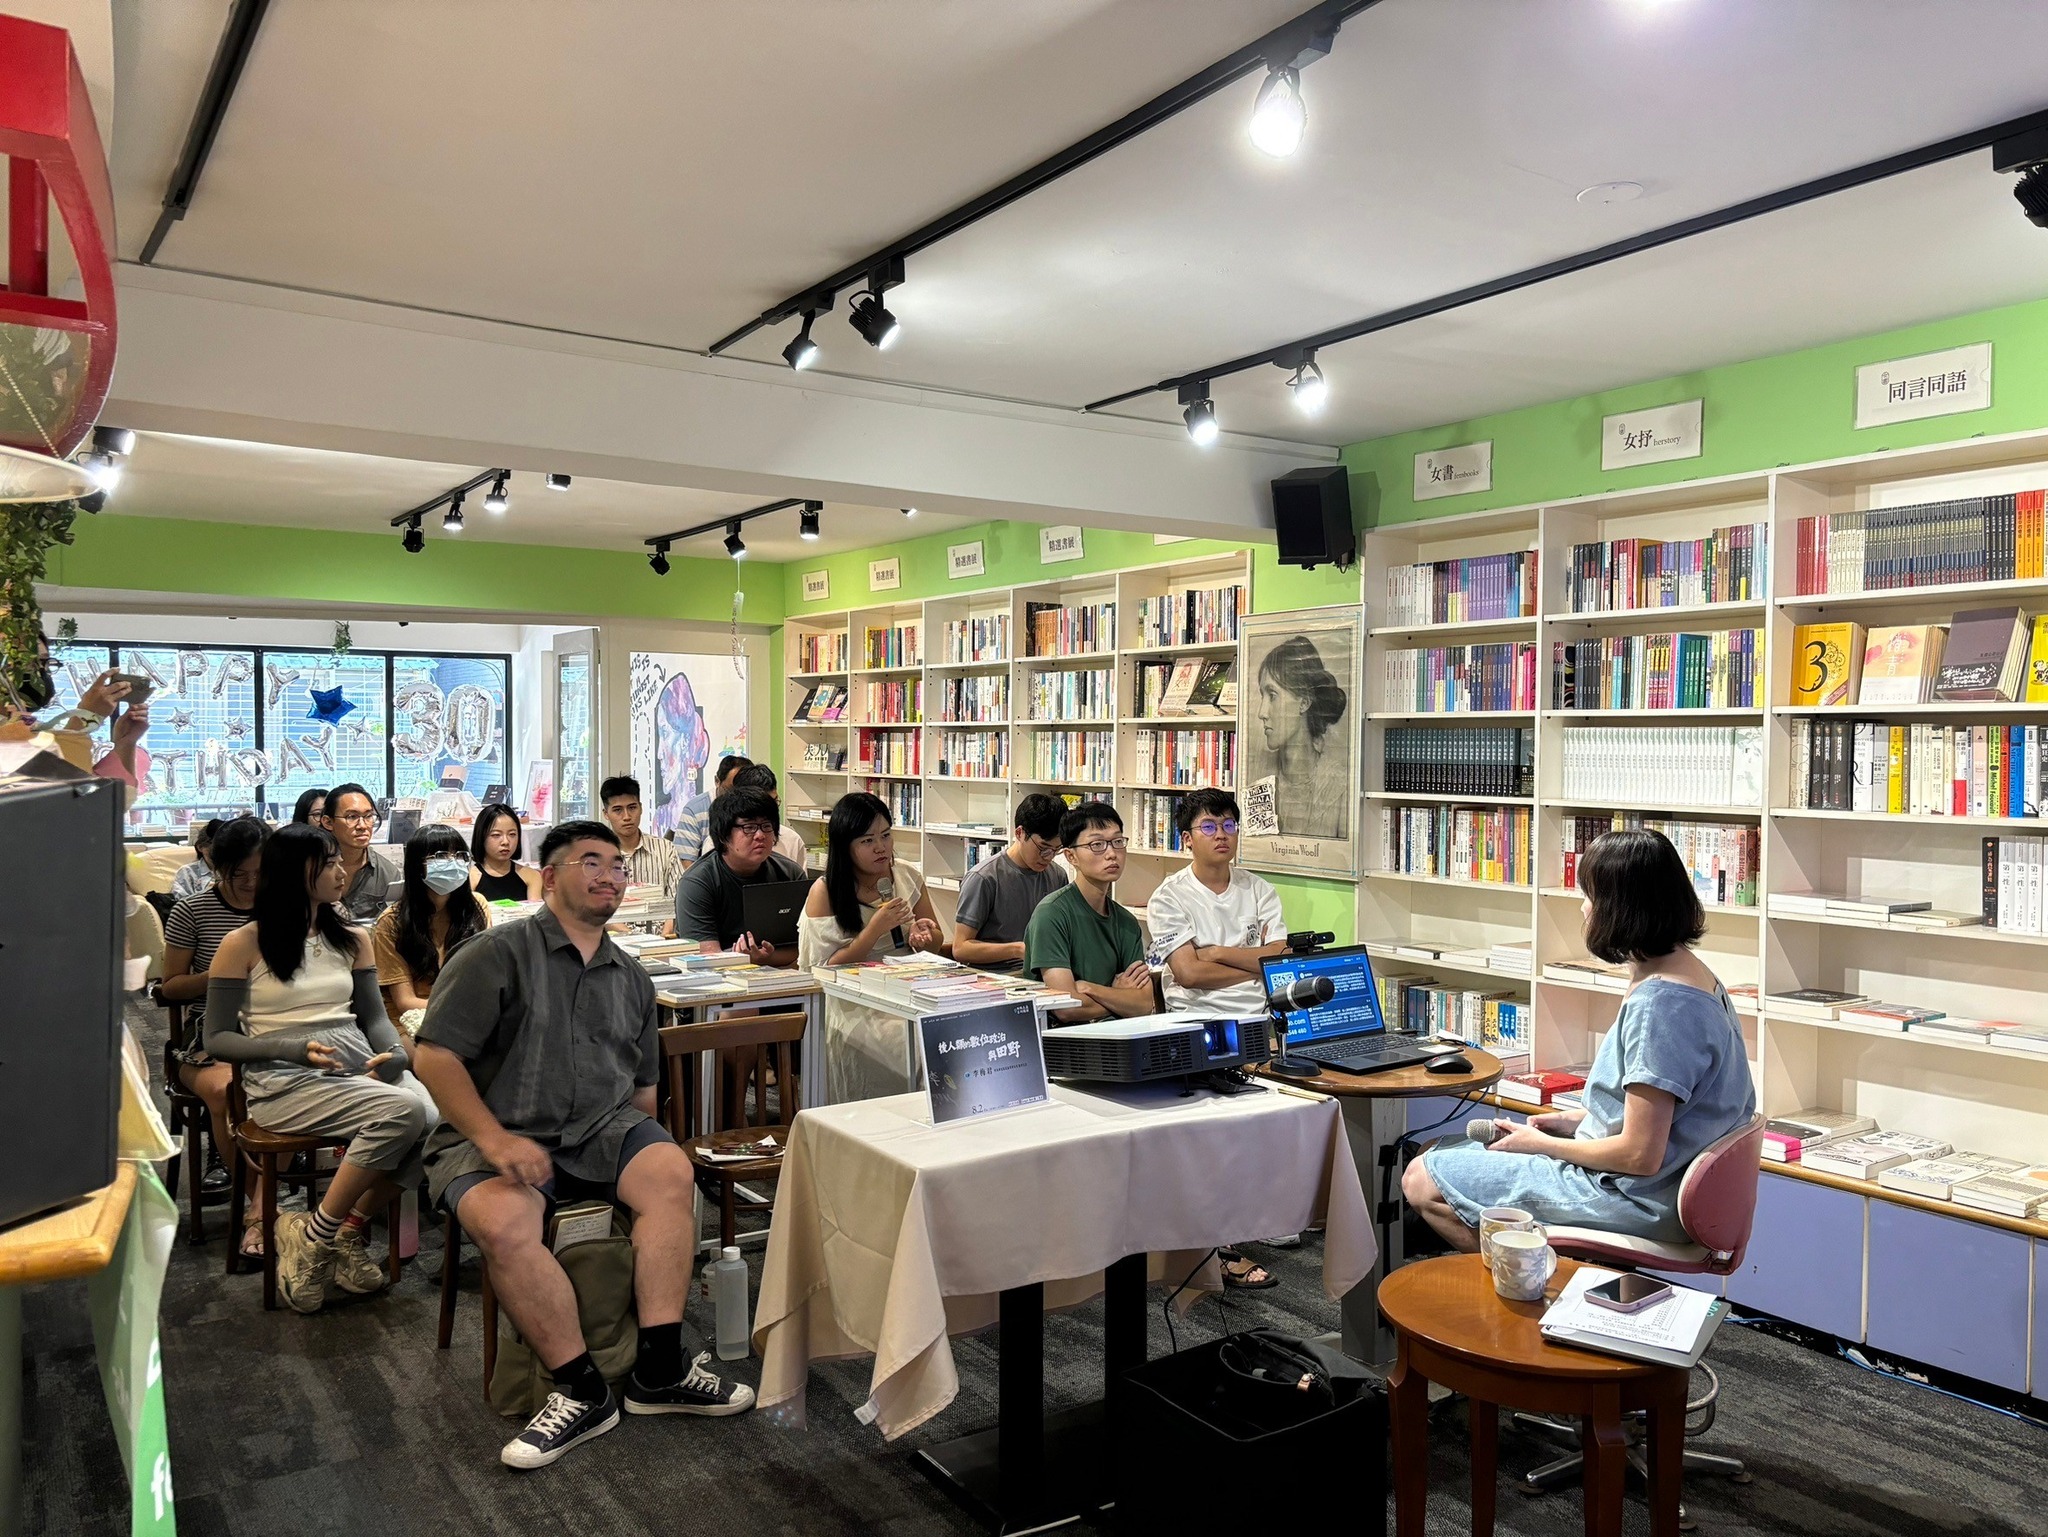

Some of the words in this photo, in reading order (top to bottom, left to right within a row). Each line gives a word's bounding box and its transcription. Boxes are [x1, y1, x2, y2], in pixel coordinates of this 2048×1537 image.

[1888, 370, 1967, 403] 同言同語
[1623, 429, 1653, 451] 女抒
[1653, 436, 1681, 446] herstory
[1430, 464, 1454, 483] 女書
[1454, 469, 1480, 480] fembooks
[64, 649, 300, 710] HAPPY
[391, 680, 498, 765] 30
[1990, 772, 1998, 790] Michel
[1247, 795, 1264, 806] WHAT
[1989, 791, 1997, 815] Foucault
[1270, 842, 1300, 857] Virginia
[1299, 843, 1320, 858] Woolf
[988, 1041, 1021, 1061] 與田野
